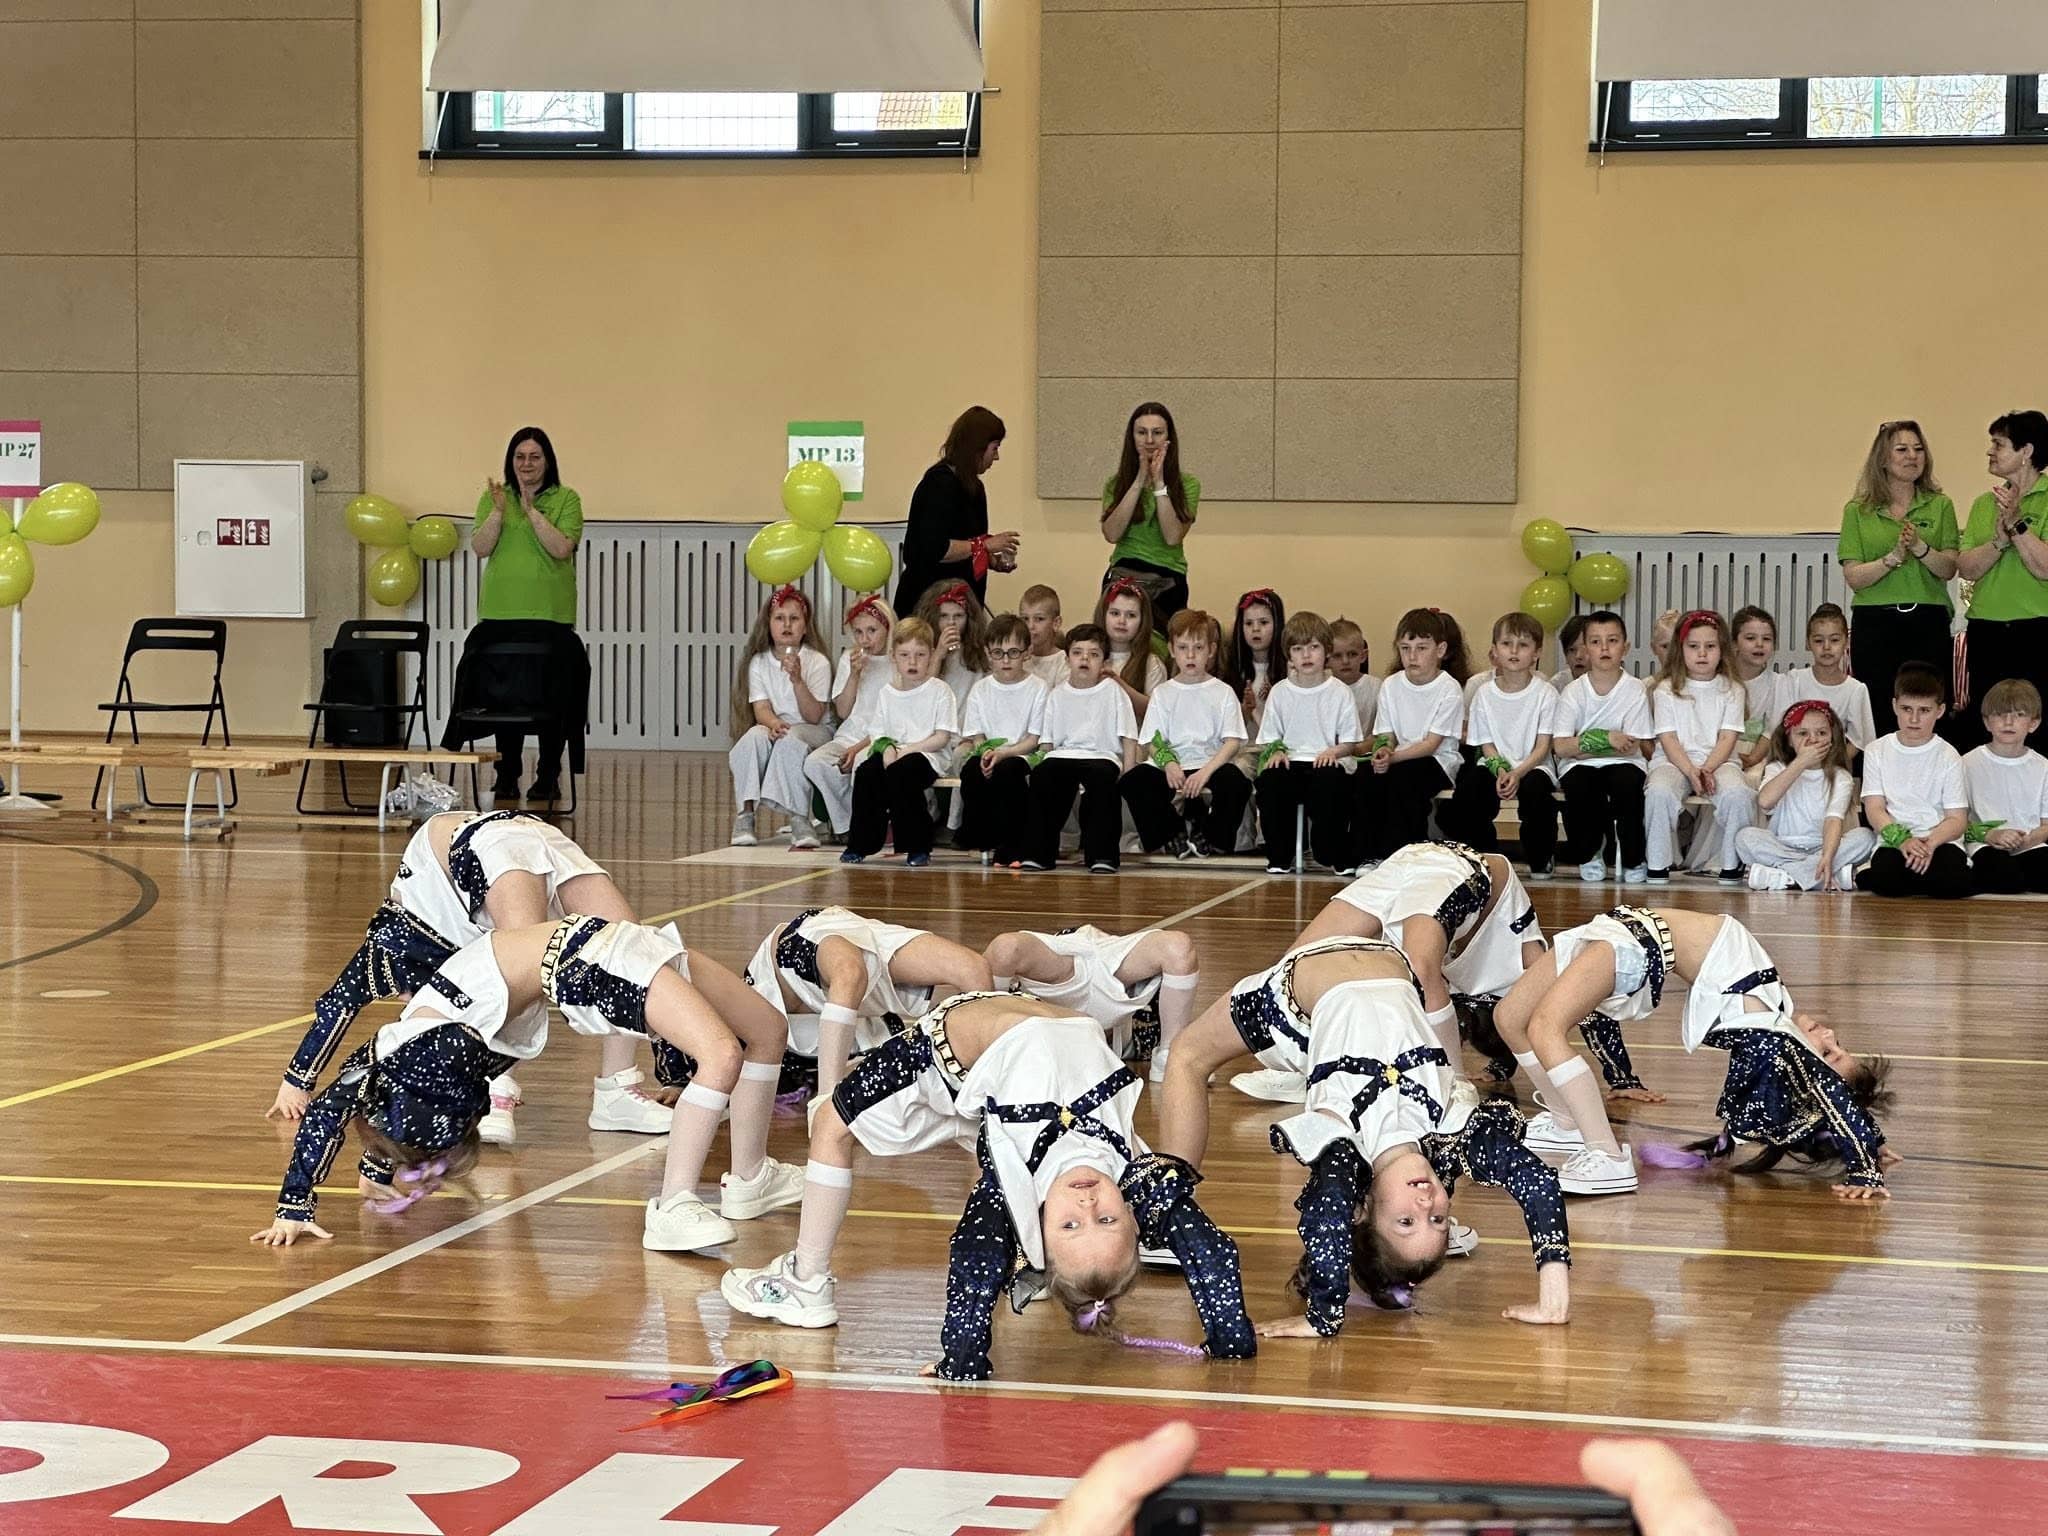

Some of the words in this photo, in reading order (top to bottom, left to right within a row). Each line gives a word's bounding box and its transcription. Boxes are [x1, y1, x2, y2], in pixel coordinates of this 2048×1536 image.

[0, 443, 15, 457] P
[18, 443, 36, 459] 27
[798, 447, 830, 462] MP
[836, 447, 856, 463] 13
